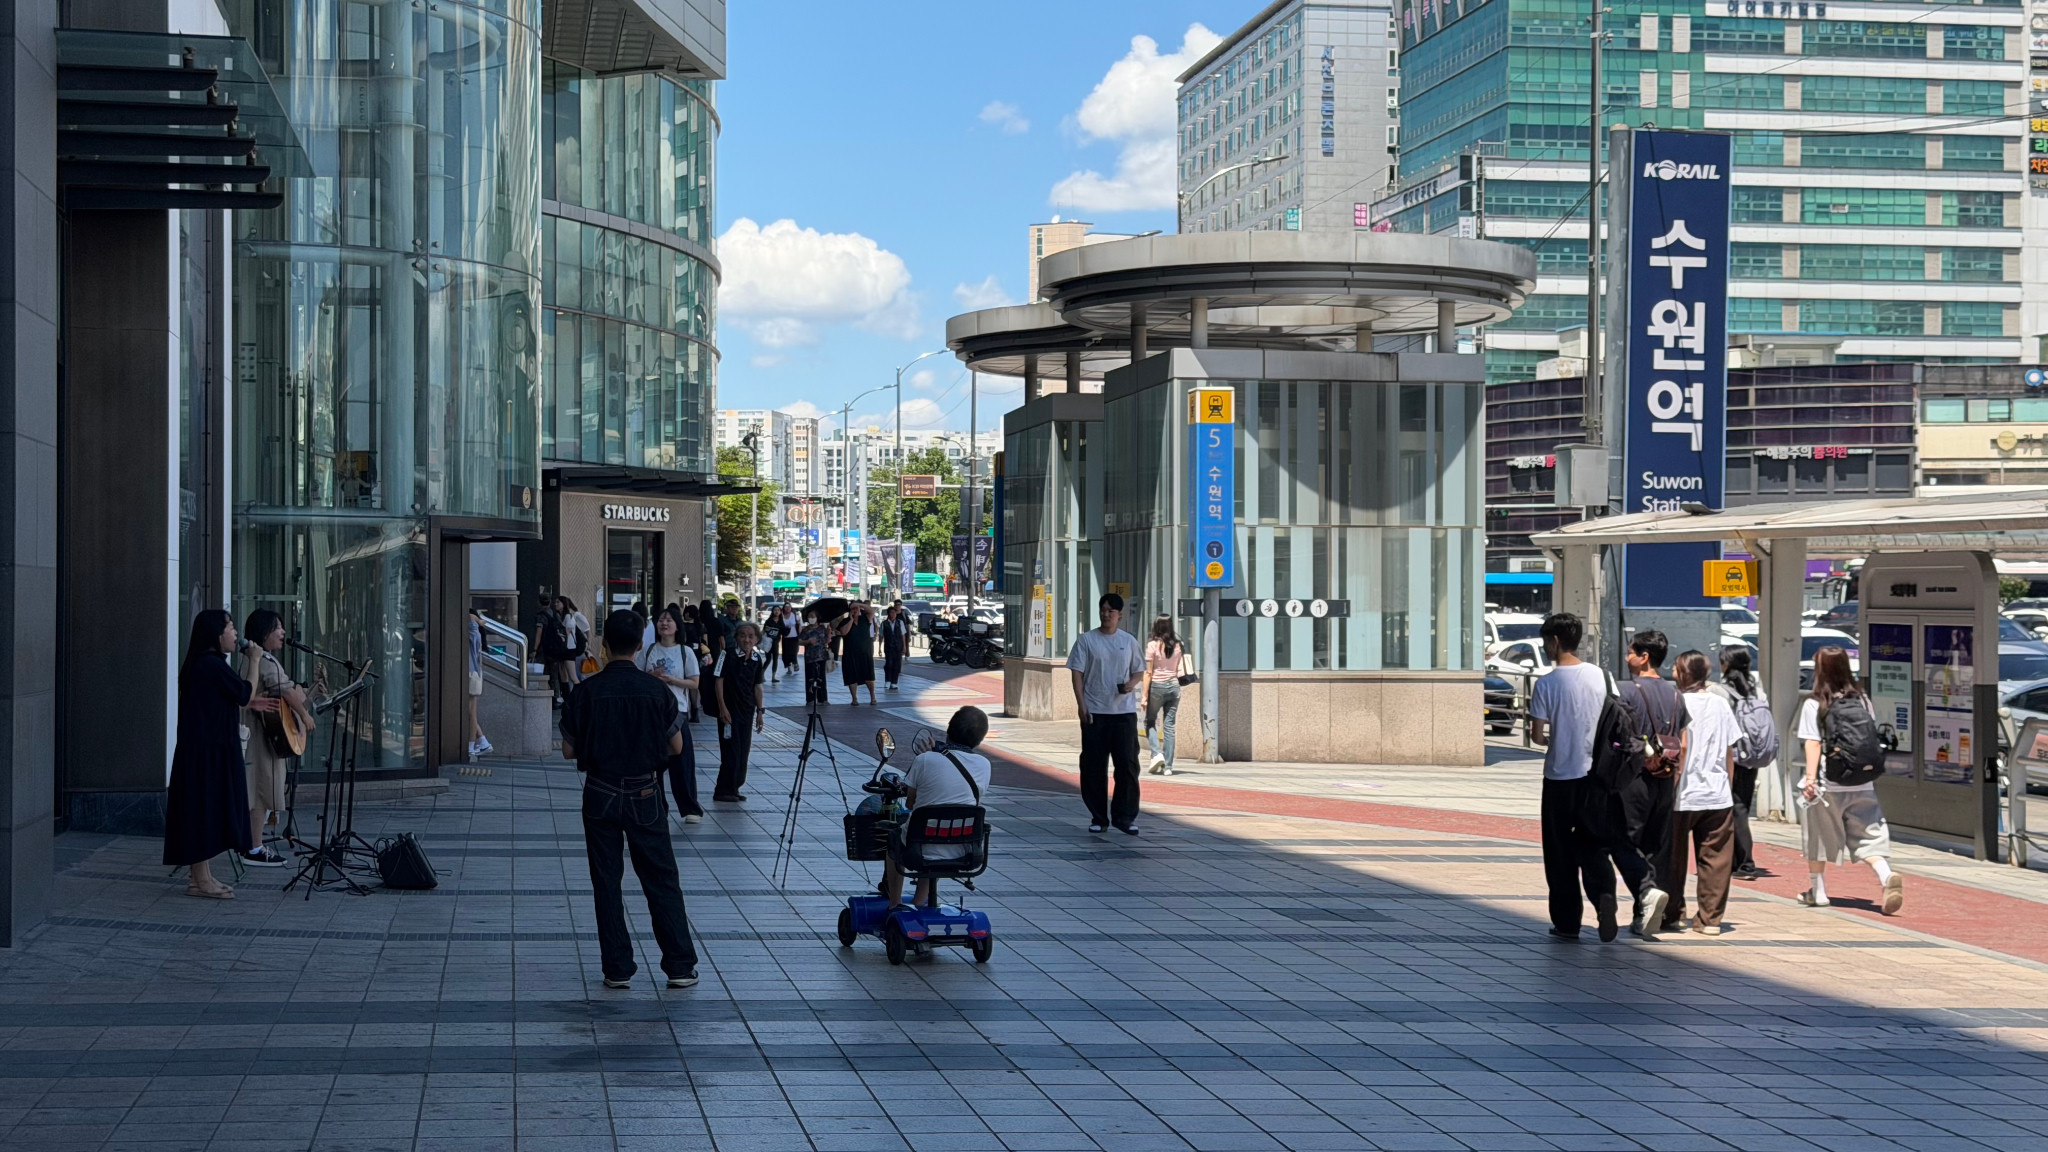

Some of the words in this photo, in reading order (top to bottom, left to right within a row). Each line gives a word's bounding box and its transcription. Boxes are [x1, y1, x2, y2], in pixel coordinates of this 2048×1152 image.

[1643, 159, 1720, 180] KORAIL
[1647, 219, 1708, 452] 수원역
[1209, 428, 1221, 448] 5
[1642, 471, 1703, 490] Suwon
[1208, 465, 1222, 521] 수원역
[604, 504, 670, 522] STARBUCKS
[1212, 547, 1217, 556] 1
[1721, 584, 1747, 592] 모범택시
